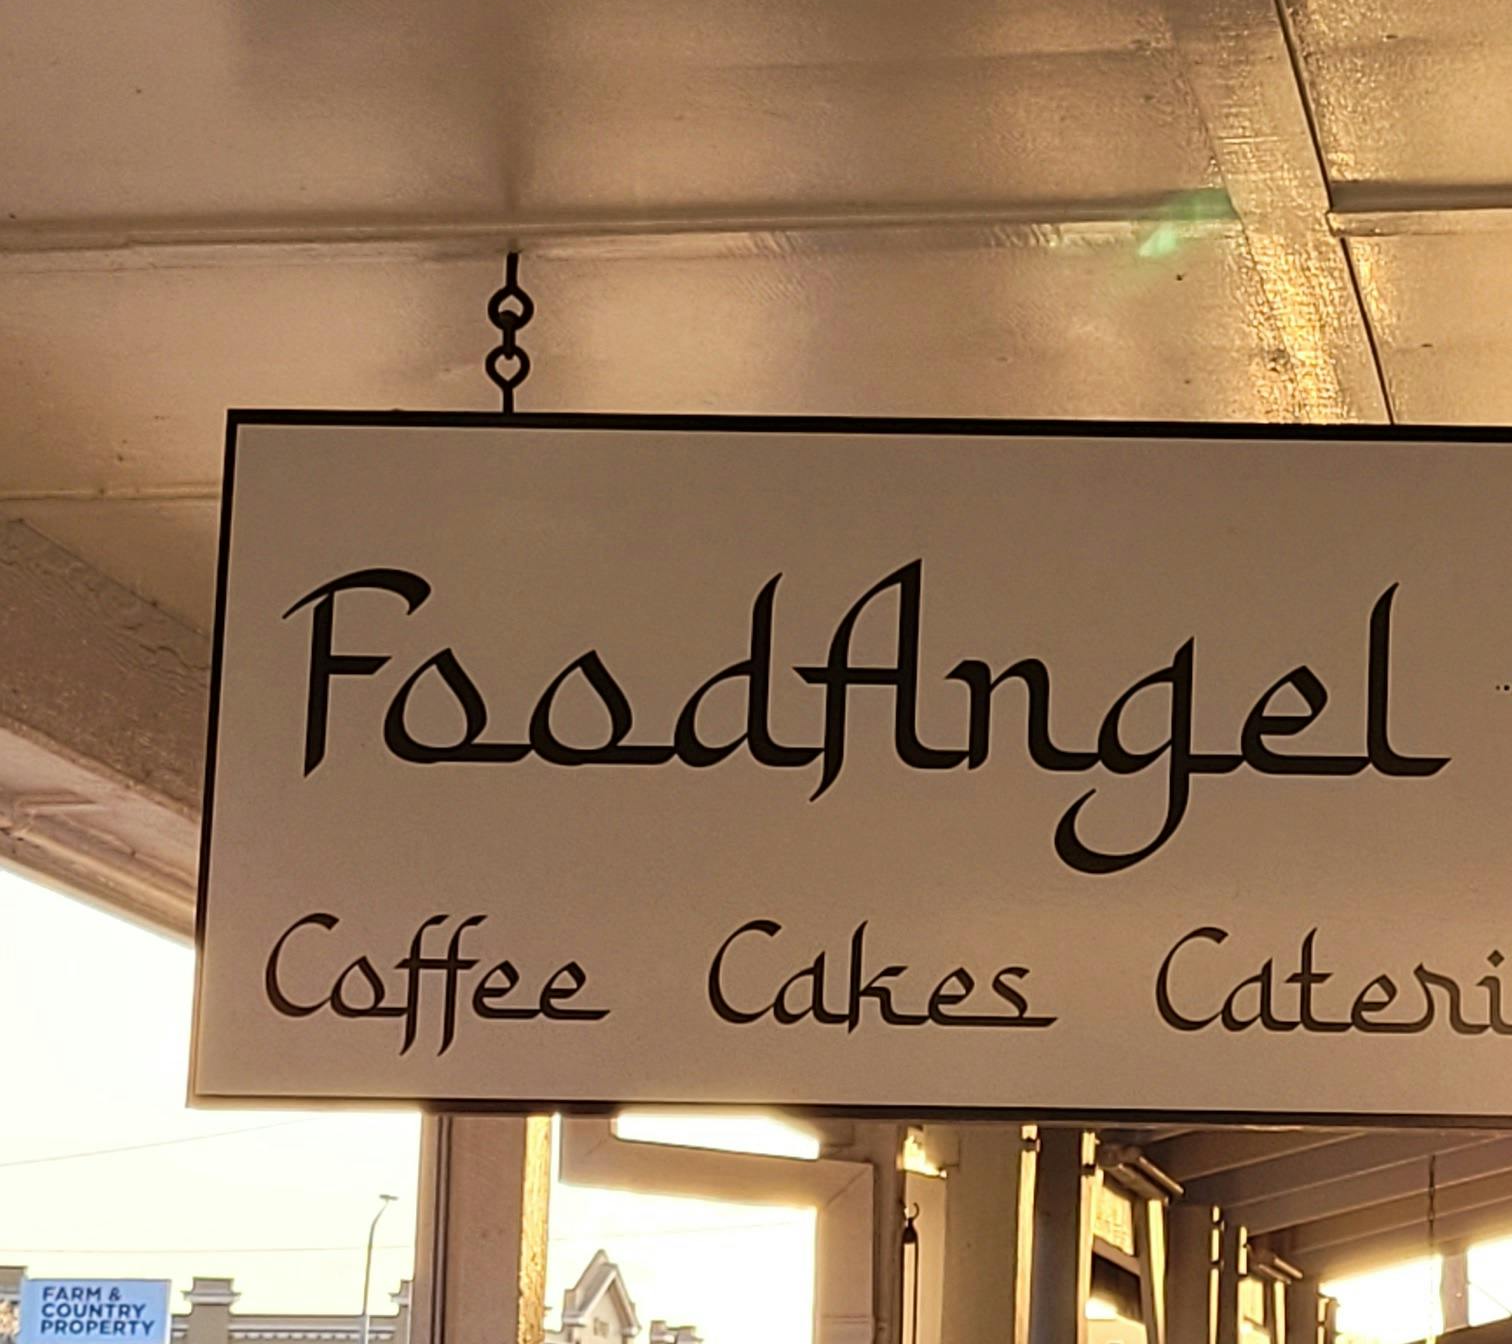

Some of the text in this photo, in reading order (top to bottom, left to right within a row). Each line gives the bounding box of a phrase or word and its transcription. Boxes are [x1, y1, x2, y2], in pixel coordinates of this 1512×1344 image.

[282, 559, 1452, 874] FoodAngel
[264, 913, 612, 1056] Coffee
[708, 920, 1058, 1034] Cakes
[42, 1286, 122, 1302] FARM &
[41, 1303, 147, 1319] COUNTRY
[40, 1319, 156, 1336] PROPERTY
